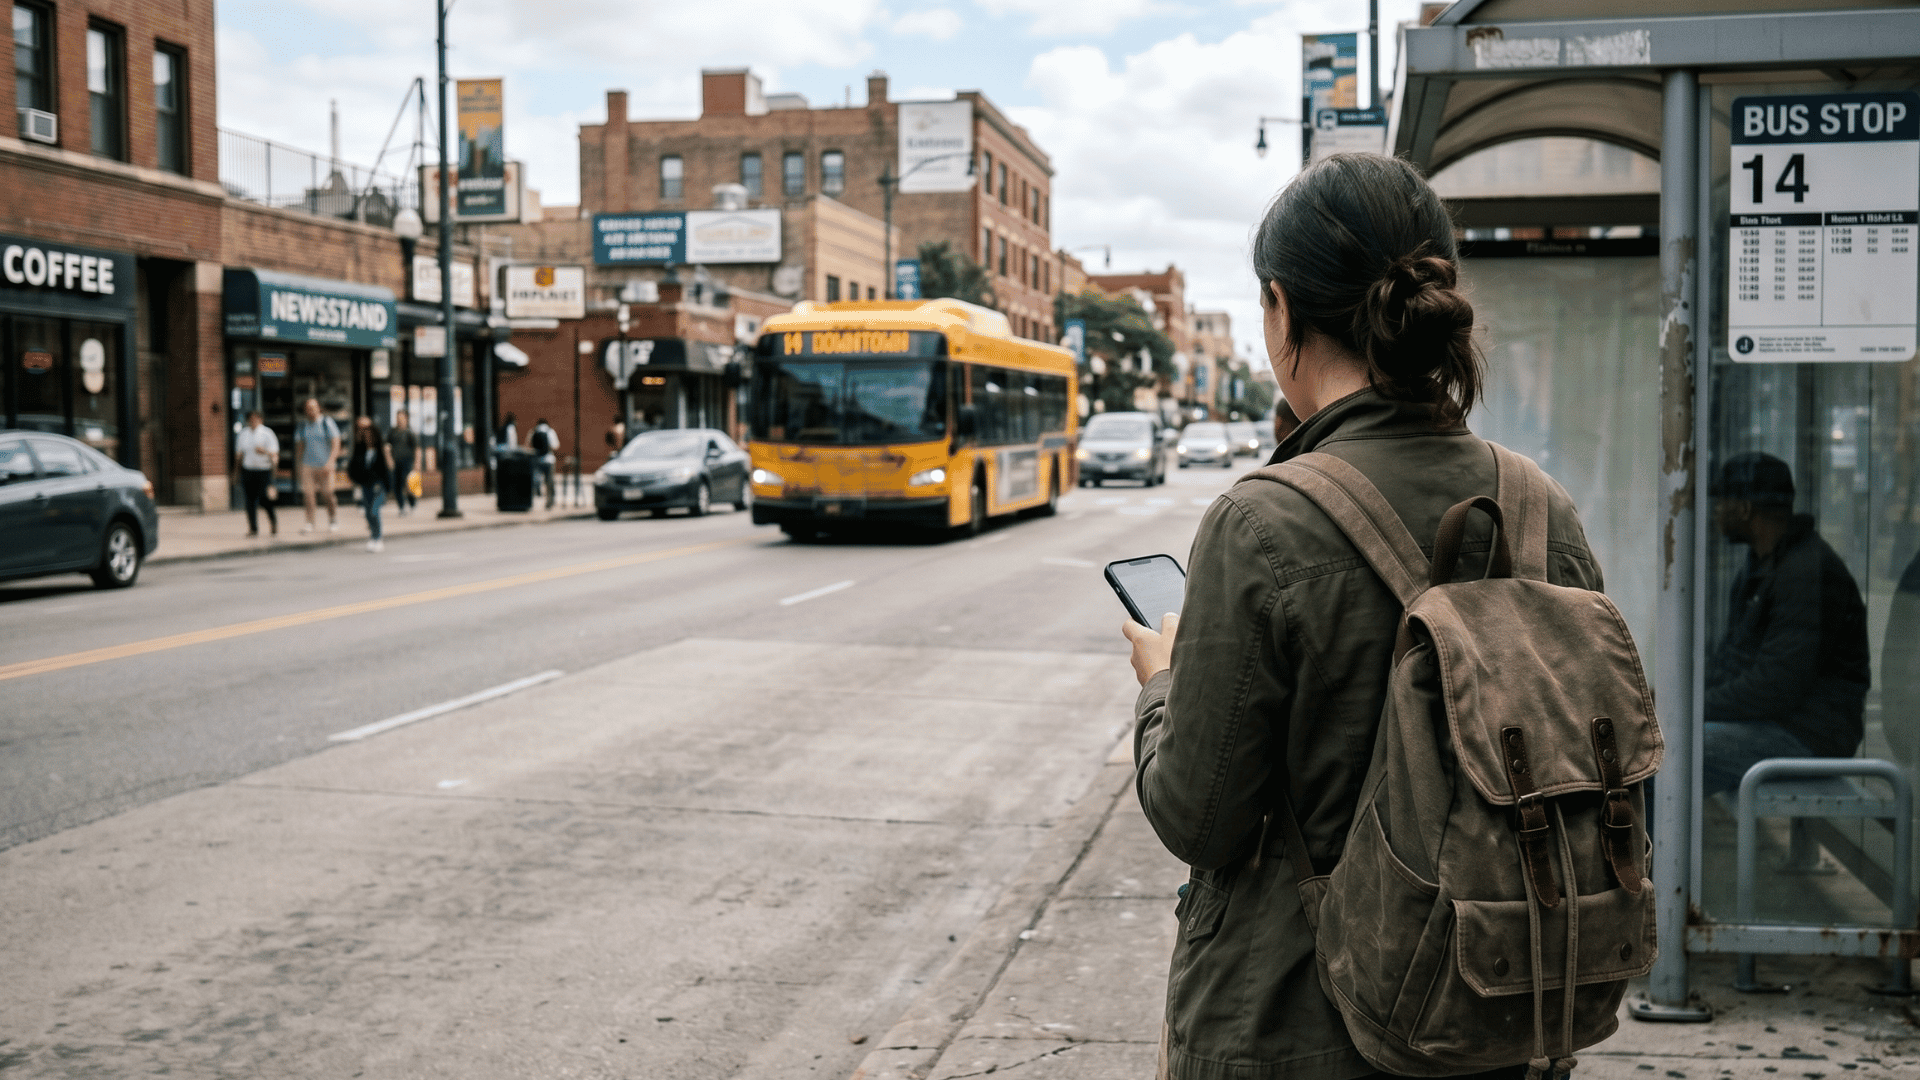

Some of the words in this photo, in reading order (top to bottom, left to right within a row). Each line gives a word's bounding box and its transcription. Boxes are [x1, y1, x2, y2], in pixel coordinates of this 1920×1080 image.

[1743, 104, 1810, 137] BUS
[1819, 101, 1907, 135] STOP
[1742, 153, 1809, 204] 14
[3, 244, 115, 295] COFFEE
[270, 290, 389, 332] NEWSSTAND
[811, 330, 910, 354] DOWNTOWN
